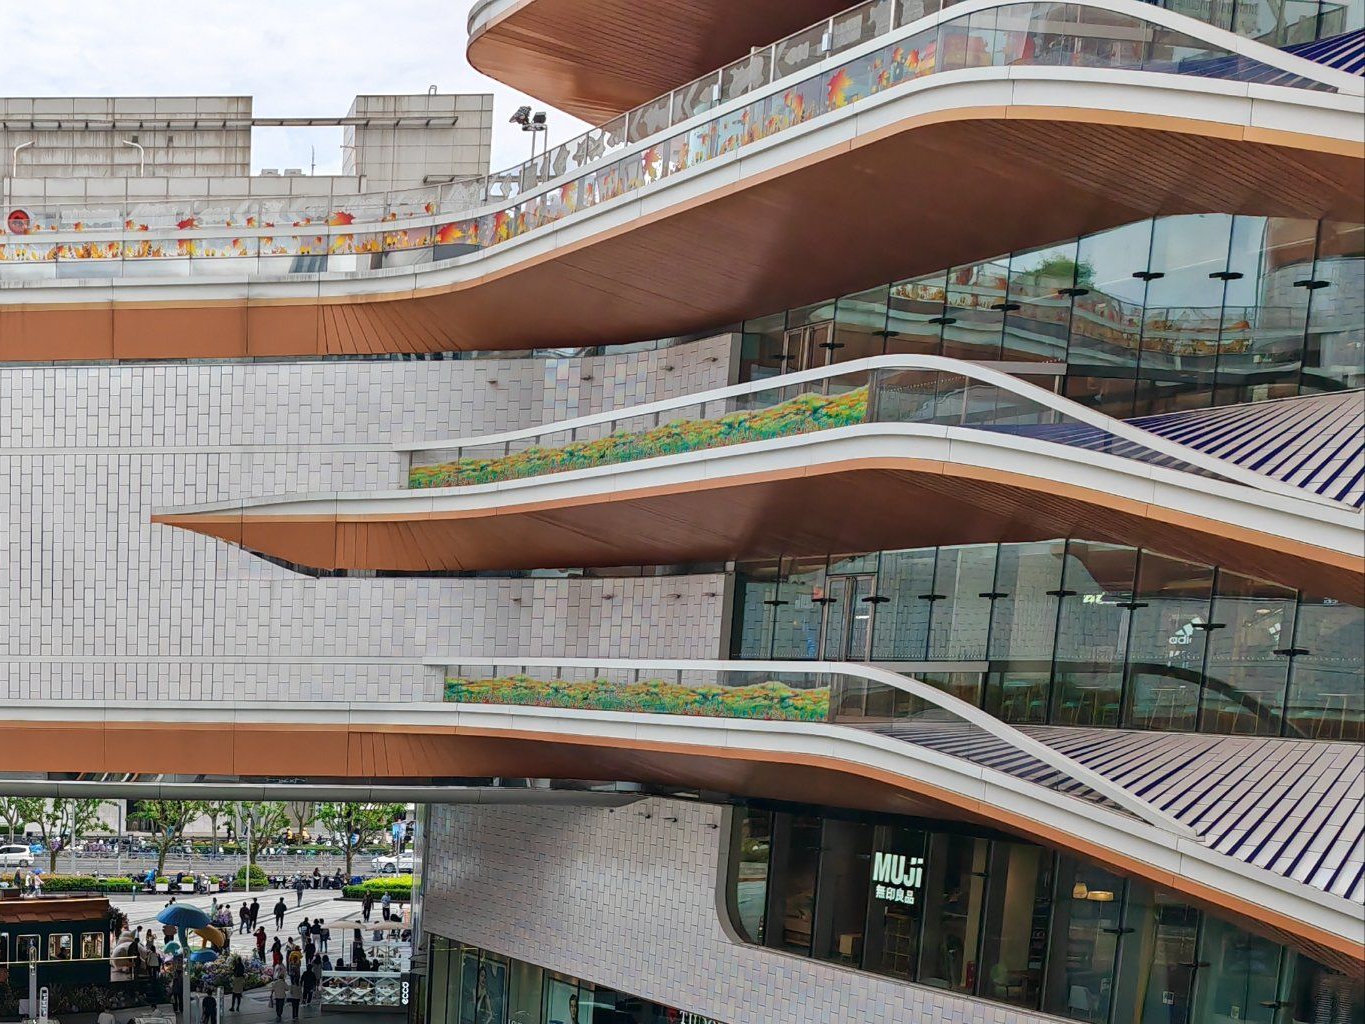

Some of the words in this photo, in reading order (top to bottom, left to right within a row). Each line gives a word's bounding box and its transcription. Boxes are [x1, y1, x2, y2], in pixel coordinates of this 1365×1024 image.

[875, 884, 915, 905] 無印良品
[401, 982, 410, 1005] ecco
